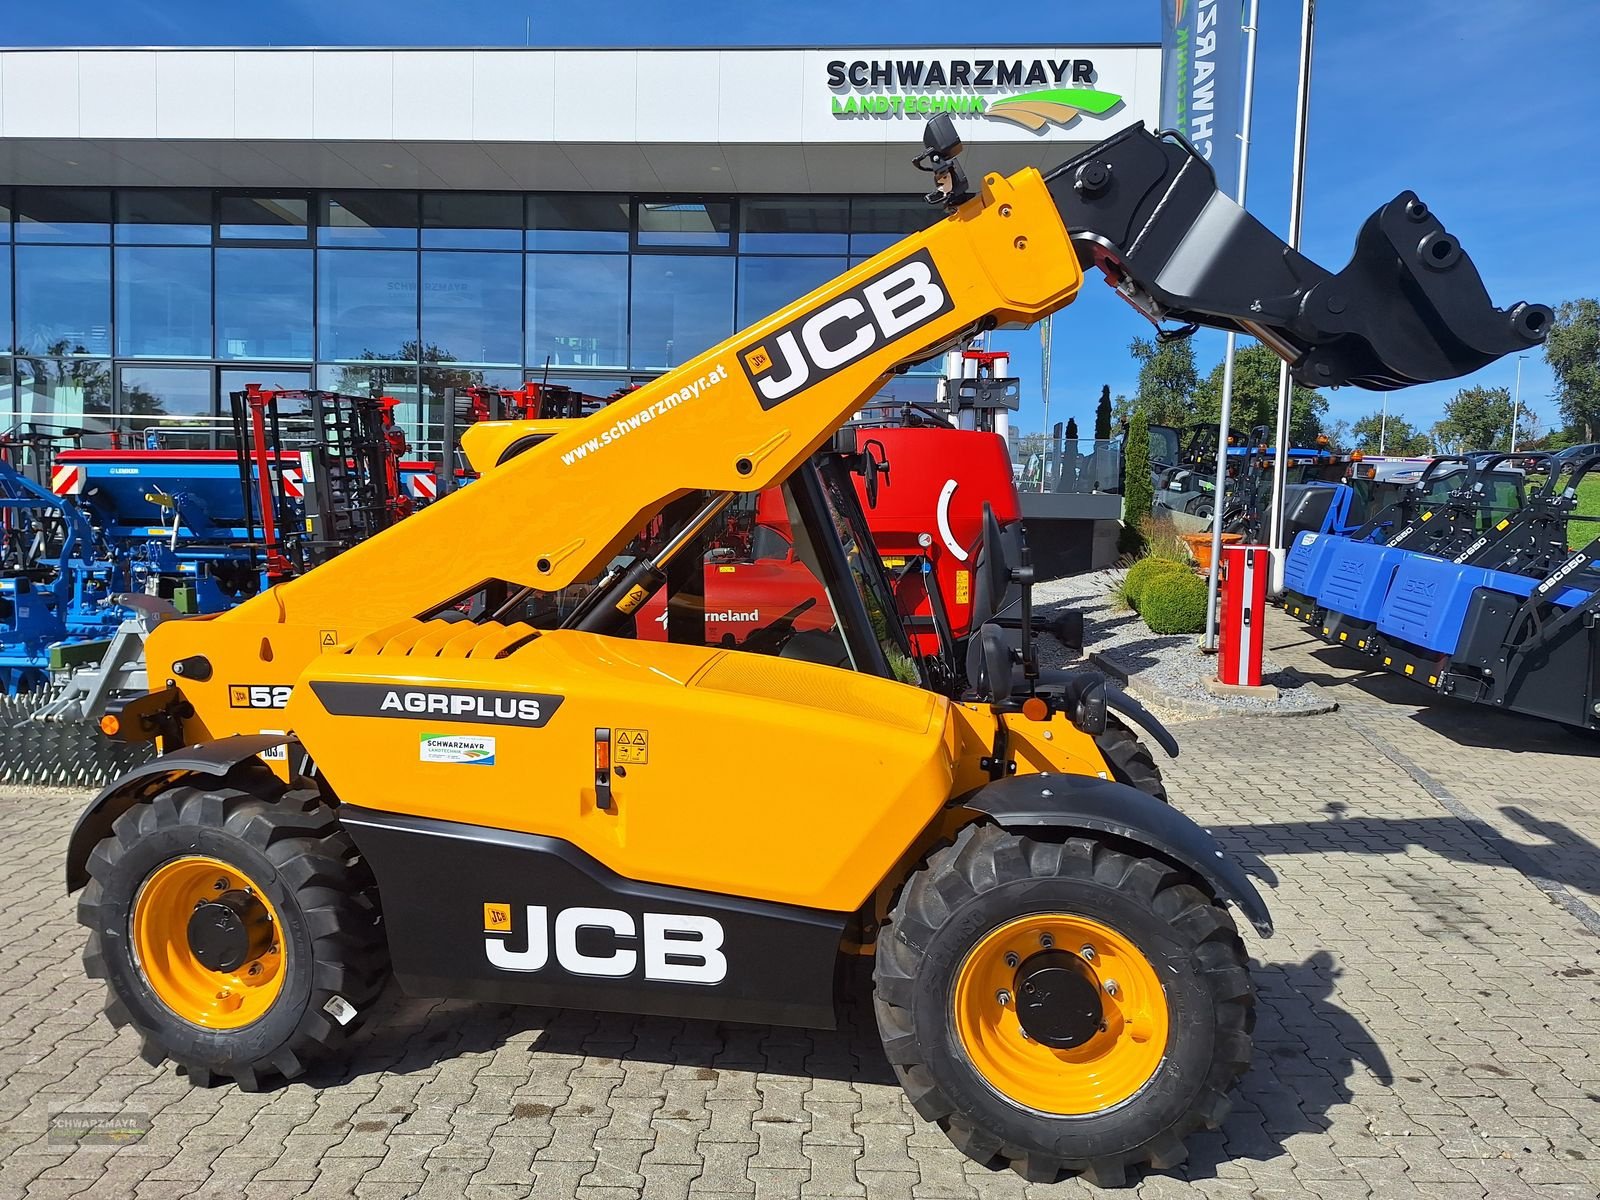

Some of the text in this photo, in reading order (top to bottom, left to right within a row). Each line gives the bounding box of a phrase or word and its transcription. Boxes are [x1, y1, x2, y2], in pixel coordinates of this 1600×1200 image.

[826, 59, 1095, 88] SCHWARZMAYR
[830, 94, 985, 115] LANDTECHNIK
[757, 260, 945, 401] JCB
[560, 363, 729, 467] www.schwarzmayr.at
[380, 691, 541, 721] AGRIPLUS
[427, 740, 485, 750] SCHWARZMAYR
[490, 909, 508, 925] JCB
[485, 904, 728, 984] JCB
